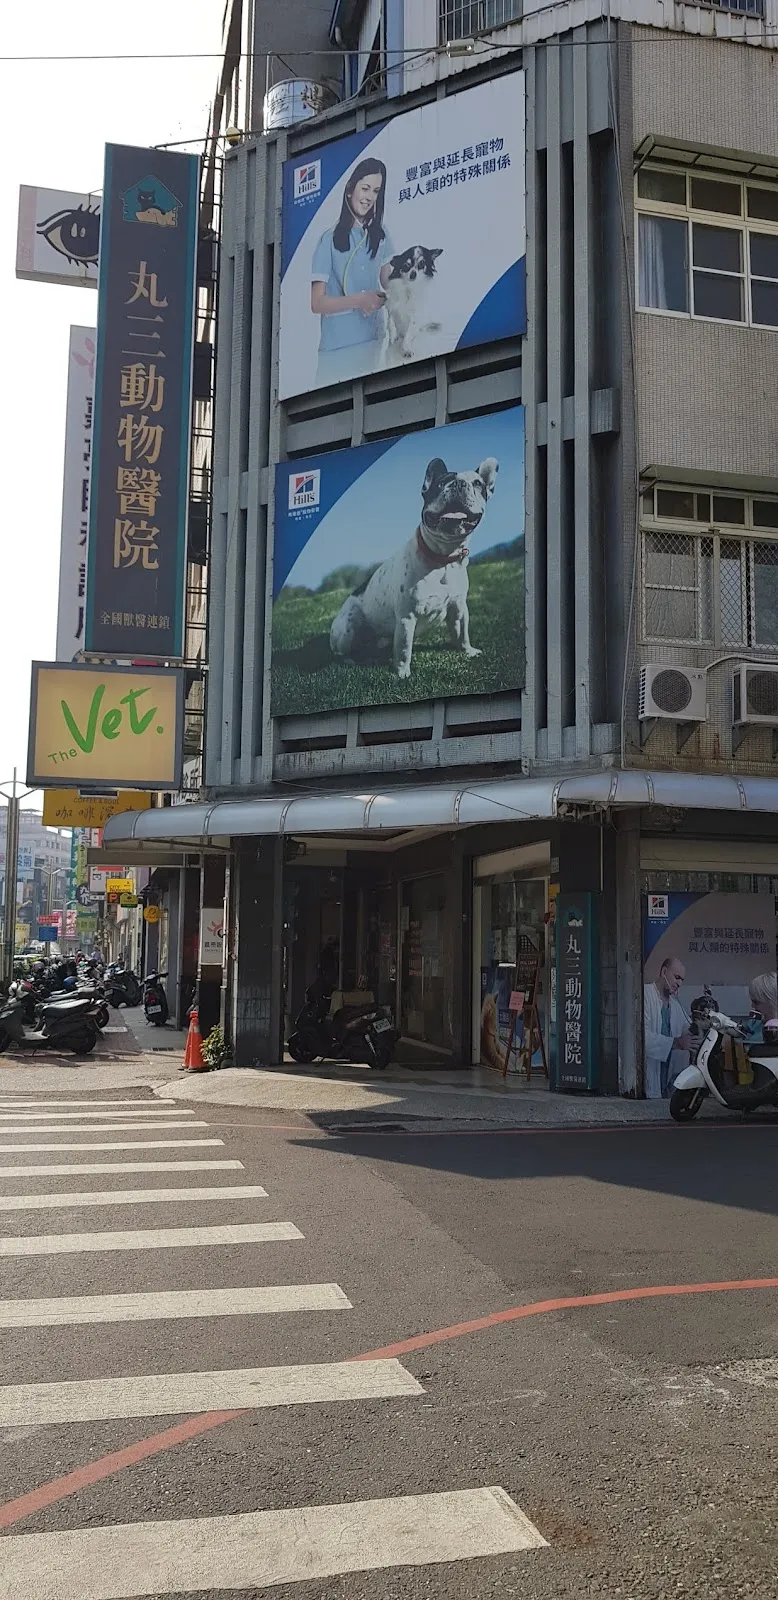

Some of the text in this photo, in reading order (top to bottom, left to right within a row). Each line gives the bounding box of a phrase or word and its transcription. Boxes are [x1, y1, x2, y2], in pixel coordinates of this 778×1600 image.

[398, 153, 511, 204] 與人類的特殊關係
[406, 137, 504, 182] 豐富與延長寵物
[113, 260, 169, 570] 丸三動物醫院
[293, 492, 316, 506] Hill's
[100, 611, 170, 630] 全國獸醫連鎖
[48, 684, 164, 765] The Vet.
[564, 934, 582, 1065] 丸三動物醫院
